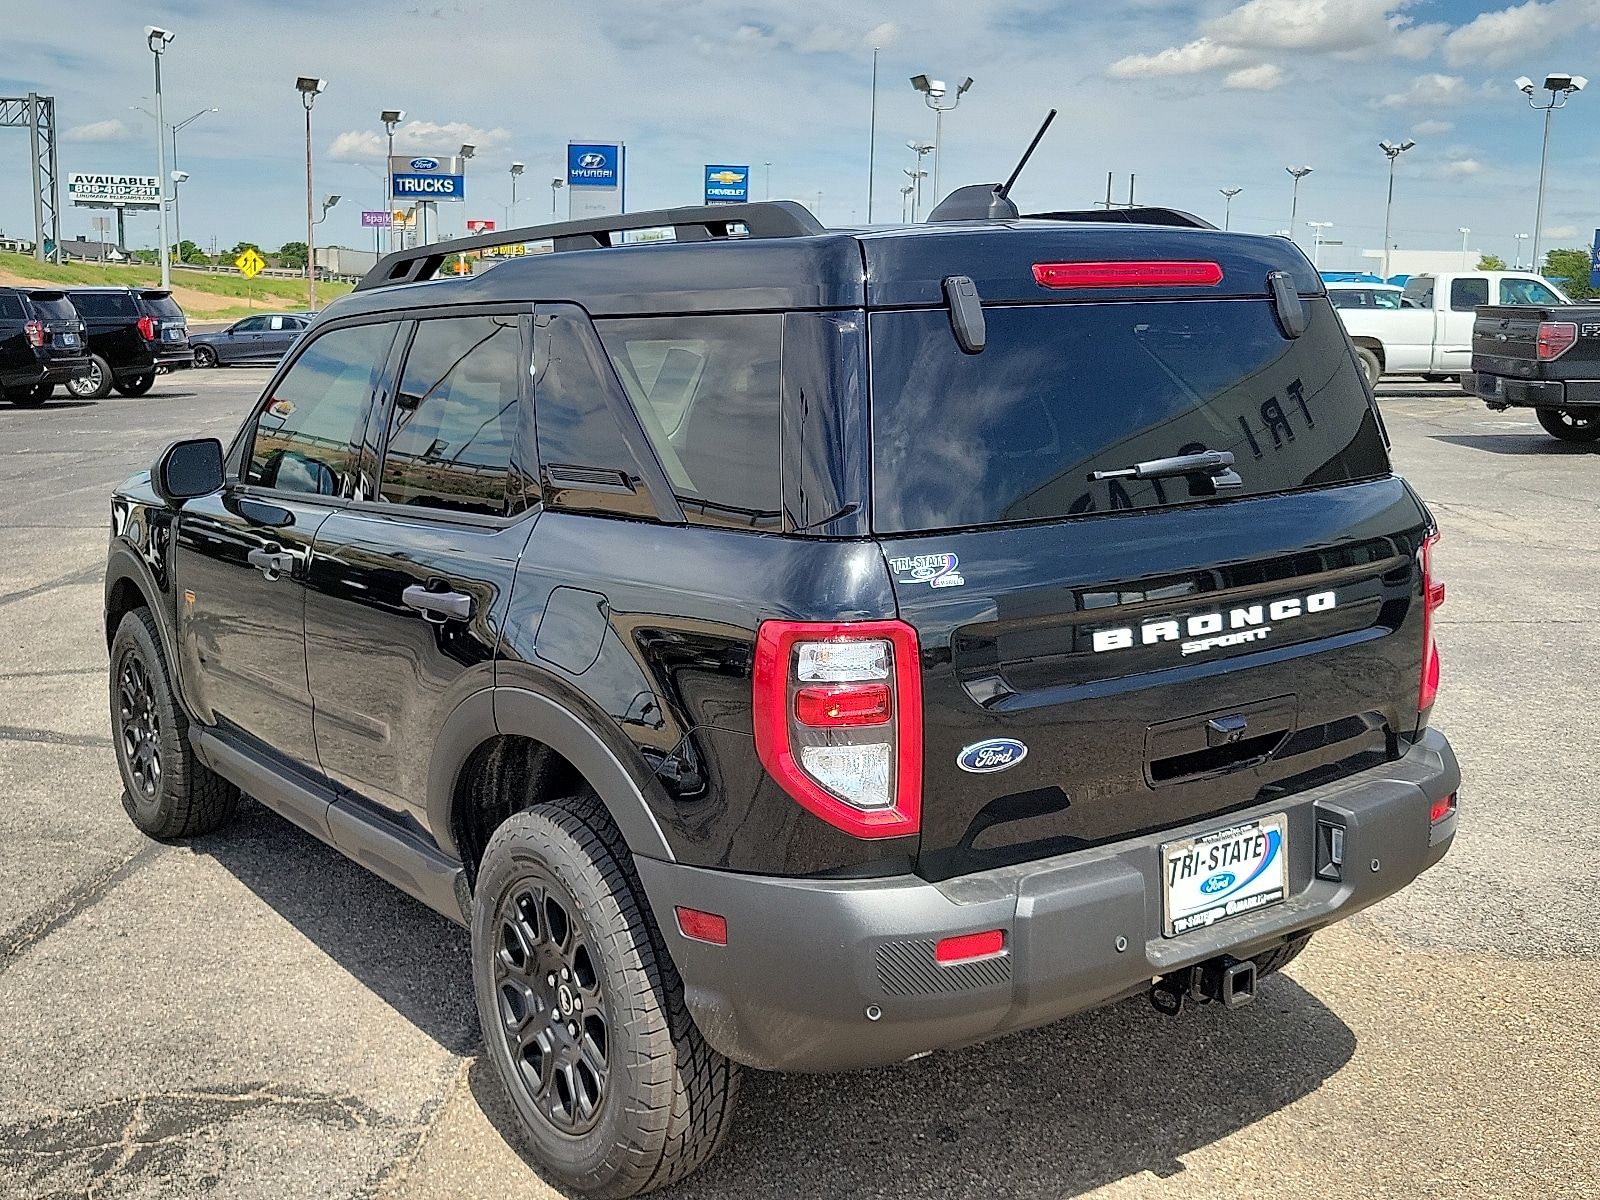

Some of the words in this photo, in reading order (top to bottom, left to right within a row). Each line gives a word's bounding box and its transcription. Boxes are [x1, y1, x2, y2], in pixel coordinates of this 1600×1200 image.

[74, 175, 156, 186] AVAILABLE
[571, 169, 613, 178] HYUNDAI
[396, 178, 454, 193] TRUCKS
[707, 188, 746, 196] CHEVROLET
[890, 555, 946, 573] TRI-STATE
[1093, 591, 1336, 652] BRONCO
[1181, 627, 1271, 657] SPORT
[1168, 835, 1263, 888] TRI-STATE
